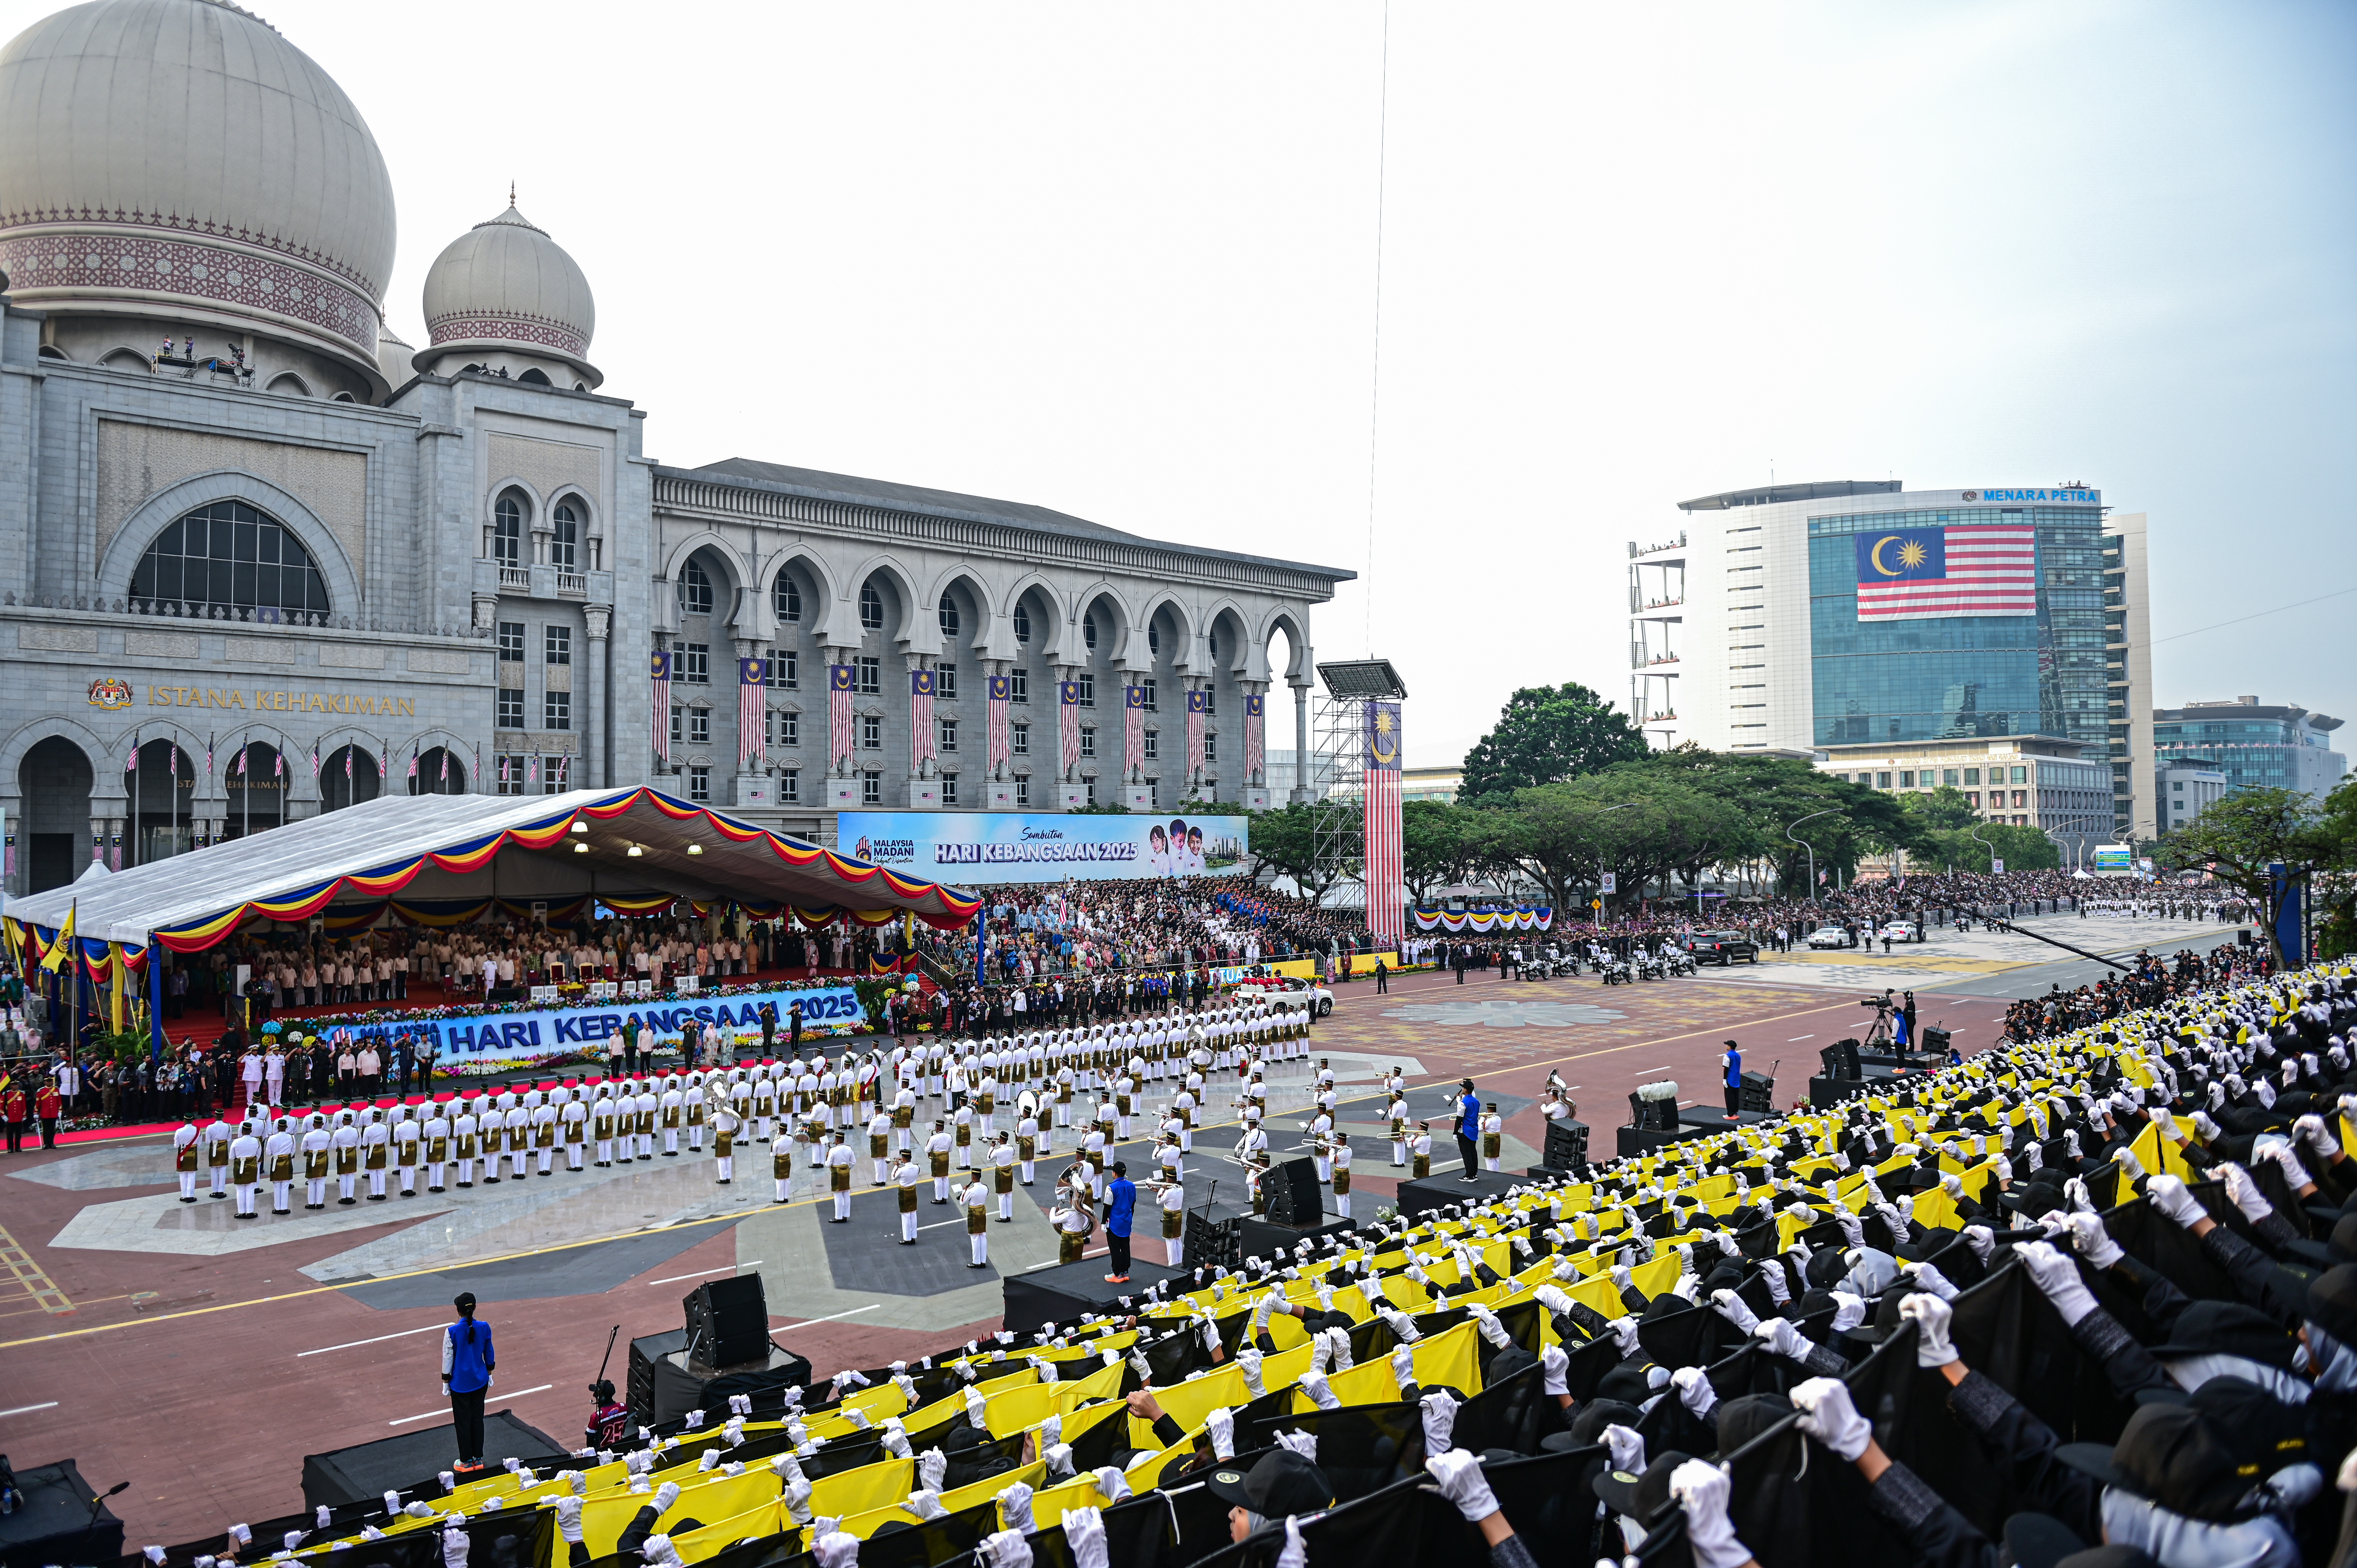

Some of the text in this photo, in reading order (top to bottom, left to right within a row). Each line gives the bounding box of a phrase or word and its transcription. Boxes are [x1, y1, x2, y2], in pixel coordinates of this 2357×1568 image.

[1984, 490, 2097, 502] MENARA PETRA
[148, 686, 415, 716] ISTANA KEHAKIMAN
[1020, 826, 1064, 841] Sambutan
[873, 847, 914, 856] MADANI
[873, 856, 891, 865] Rakyat
[934, 842, 1139, 863] HARI KEBANGSAAN 2025
[360, 1022, 440, 1040] MALAYSIA
[448, 1020, 541, 1054] HARI
[790, 993, 858, 1021] 2025
[601, 1420, 624, 1447] 25
